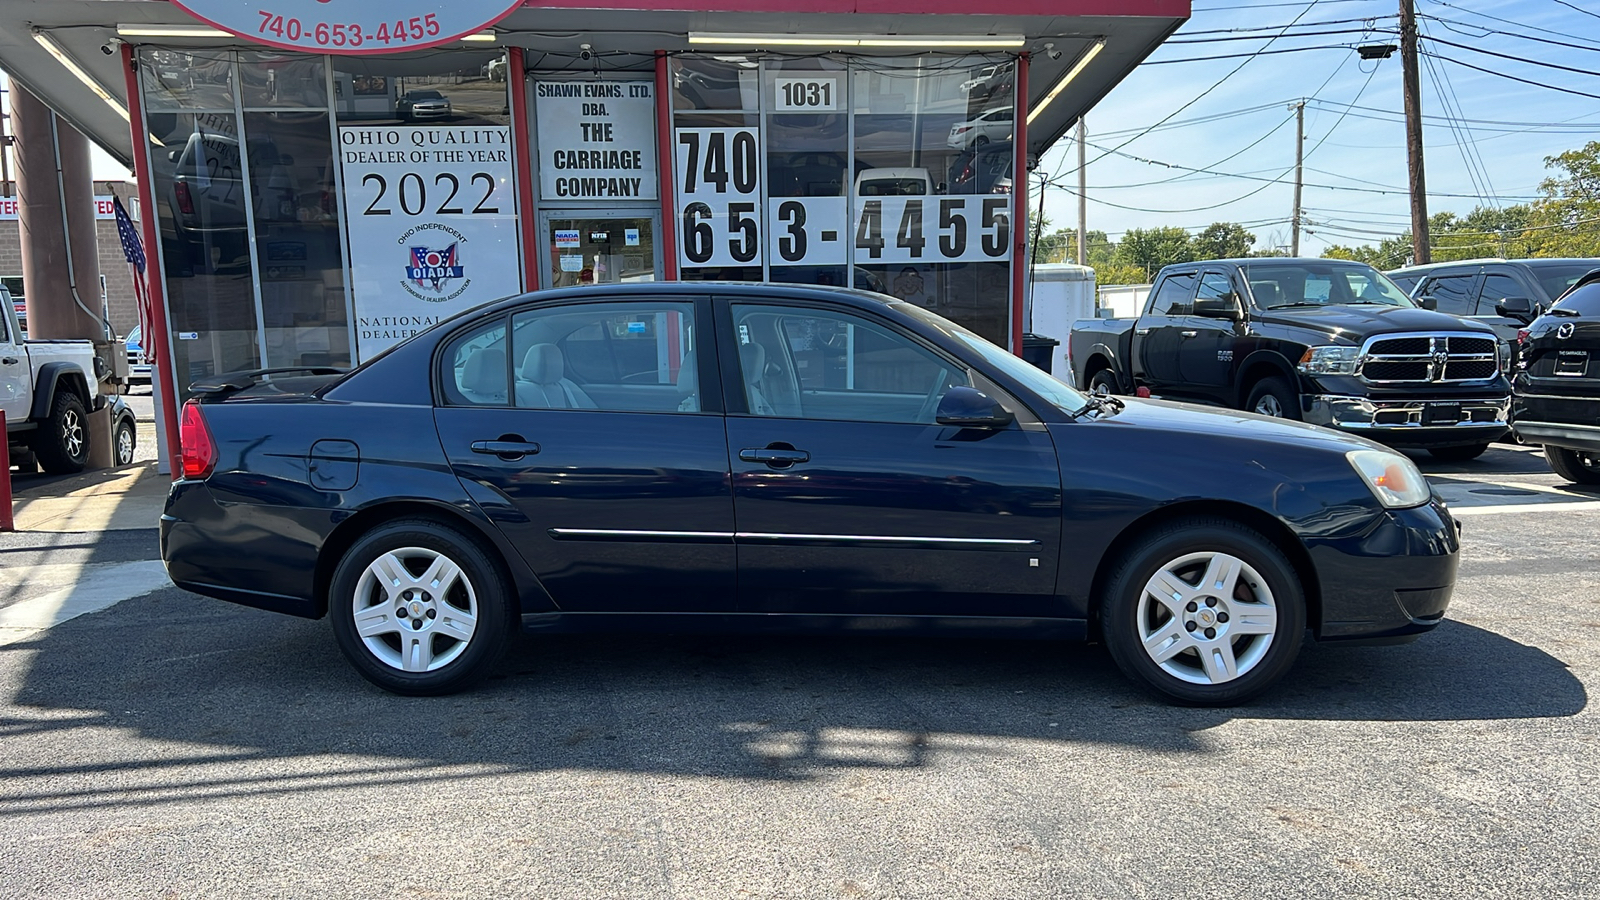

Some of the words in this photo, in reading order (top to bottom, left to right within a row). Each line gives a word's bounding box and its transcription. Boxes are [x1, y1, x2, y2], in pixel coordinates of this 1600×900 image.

[258, 10, 440, 47] 740-653-4455
[538, 84, 581, 98] SHAWN
[584, 84, 624, 98] EVANS.
[629, 85, 652, 98] LTD.
[781, 82, 831, 106] 1031
[582, 103, 610, 116] DBA.
[342, 131, 400, 145] OHIO
[411, 130, 508, 147] QUALITY
[580, 122, 614, 143] THE
[346, 151, 407, 163] DEALER
[410, 151, 430, 163] OF
[433, 150, 464, 162] THE
[467, 150, 508, 162] YEAR
[553, 150, 642, 170] CARRIAGE
[679, 131, 757, 194] 740
[362, 172, 499, 216] 2022
[555, 177, 642, 197] COMPANY
[94, 201, 114, 214] ED
[398, 228, 415, 245] OHIO
[415, 223, 468, 243] INDEPENDENT
[412, 267, 455, 279] OIADA
[400, 280, 426, 301] AUTOMOBILE
[447, 278, 471, 301] ASSOCIATION
